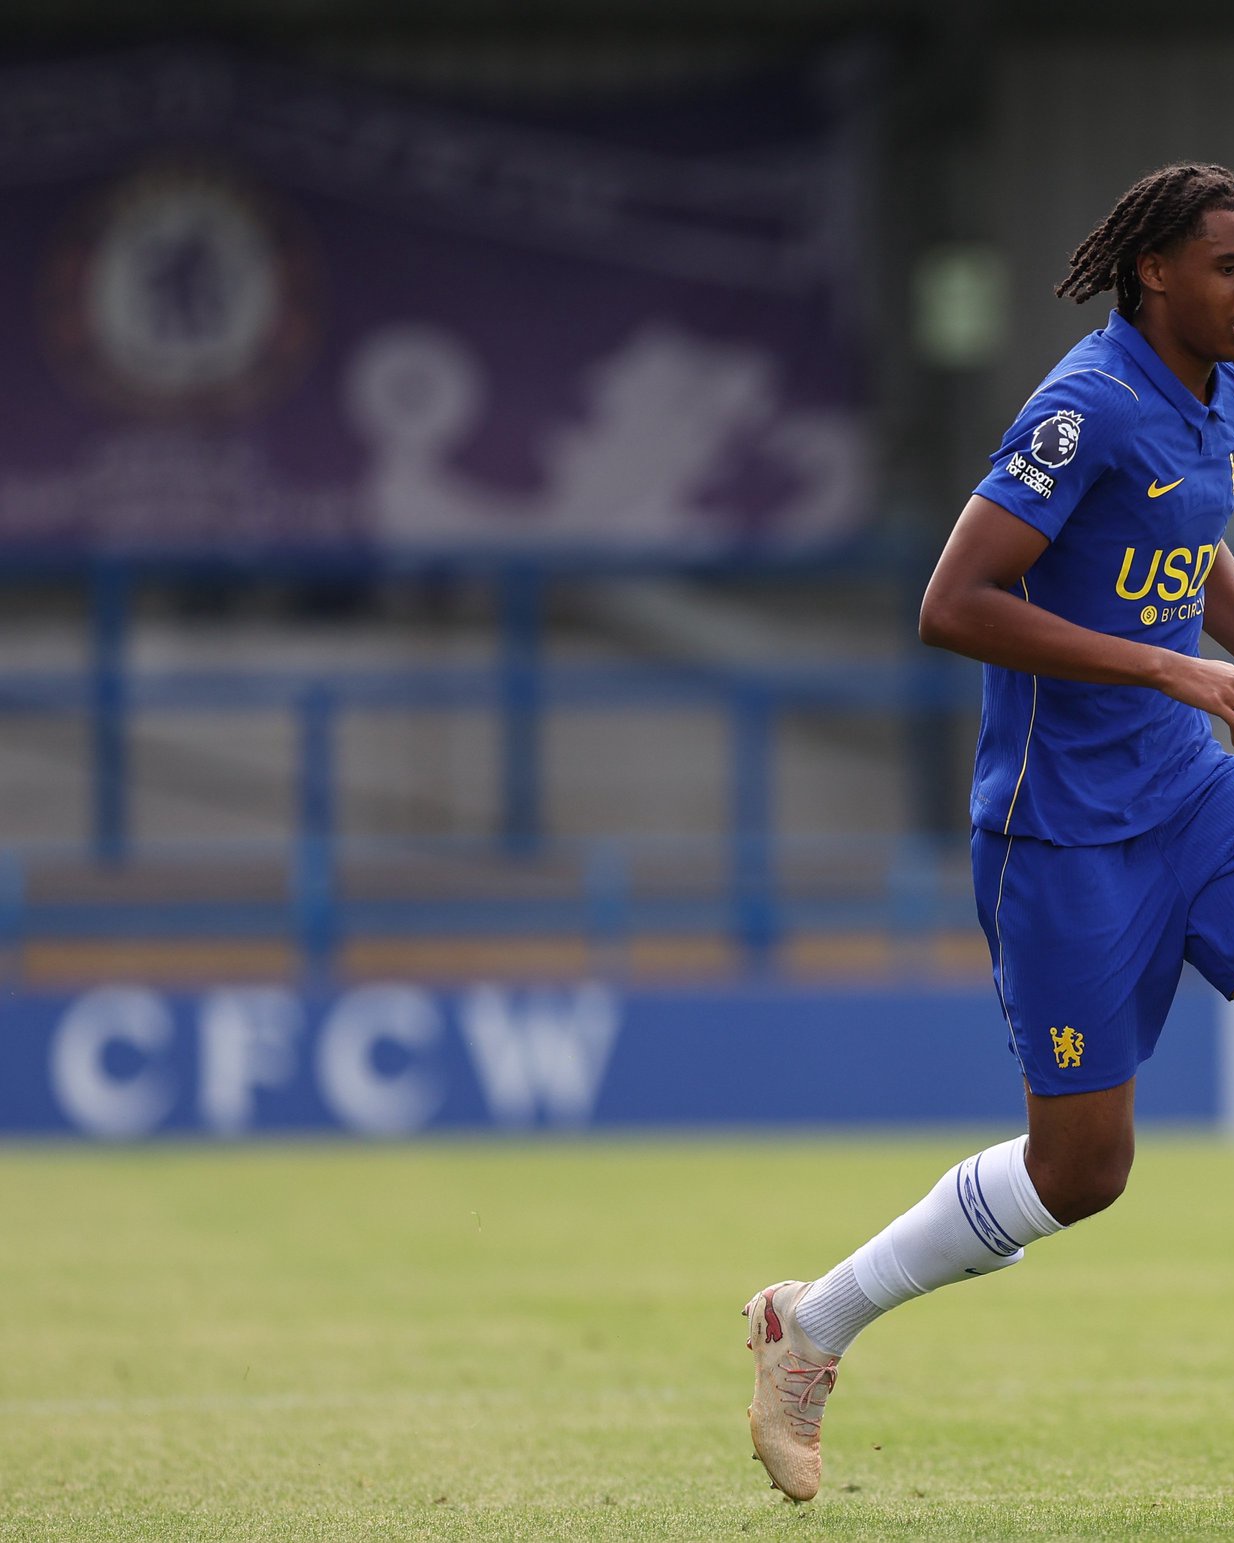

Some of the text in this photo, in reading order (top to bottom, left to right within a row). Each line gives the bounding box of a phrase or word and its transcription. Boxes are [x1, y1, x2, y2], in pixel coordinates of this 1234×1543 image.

[1005, 460, 1052, 499] for racism
[1010, 452, 1054, 489] No room
[1115, 543, 1220, 601] USD
[1161, 607, 1177, 622] BY
[48, 982, 622, 1138] CFCW
